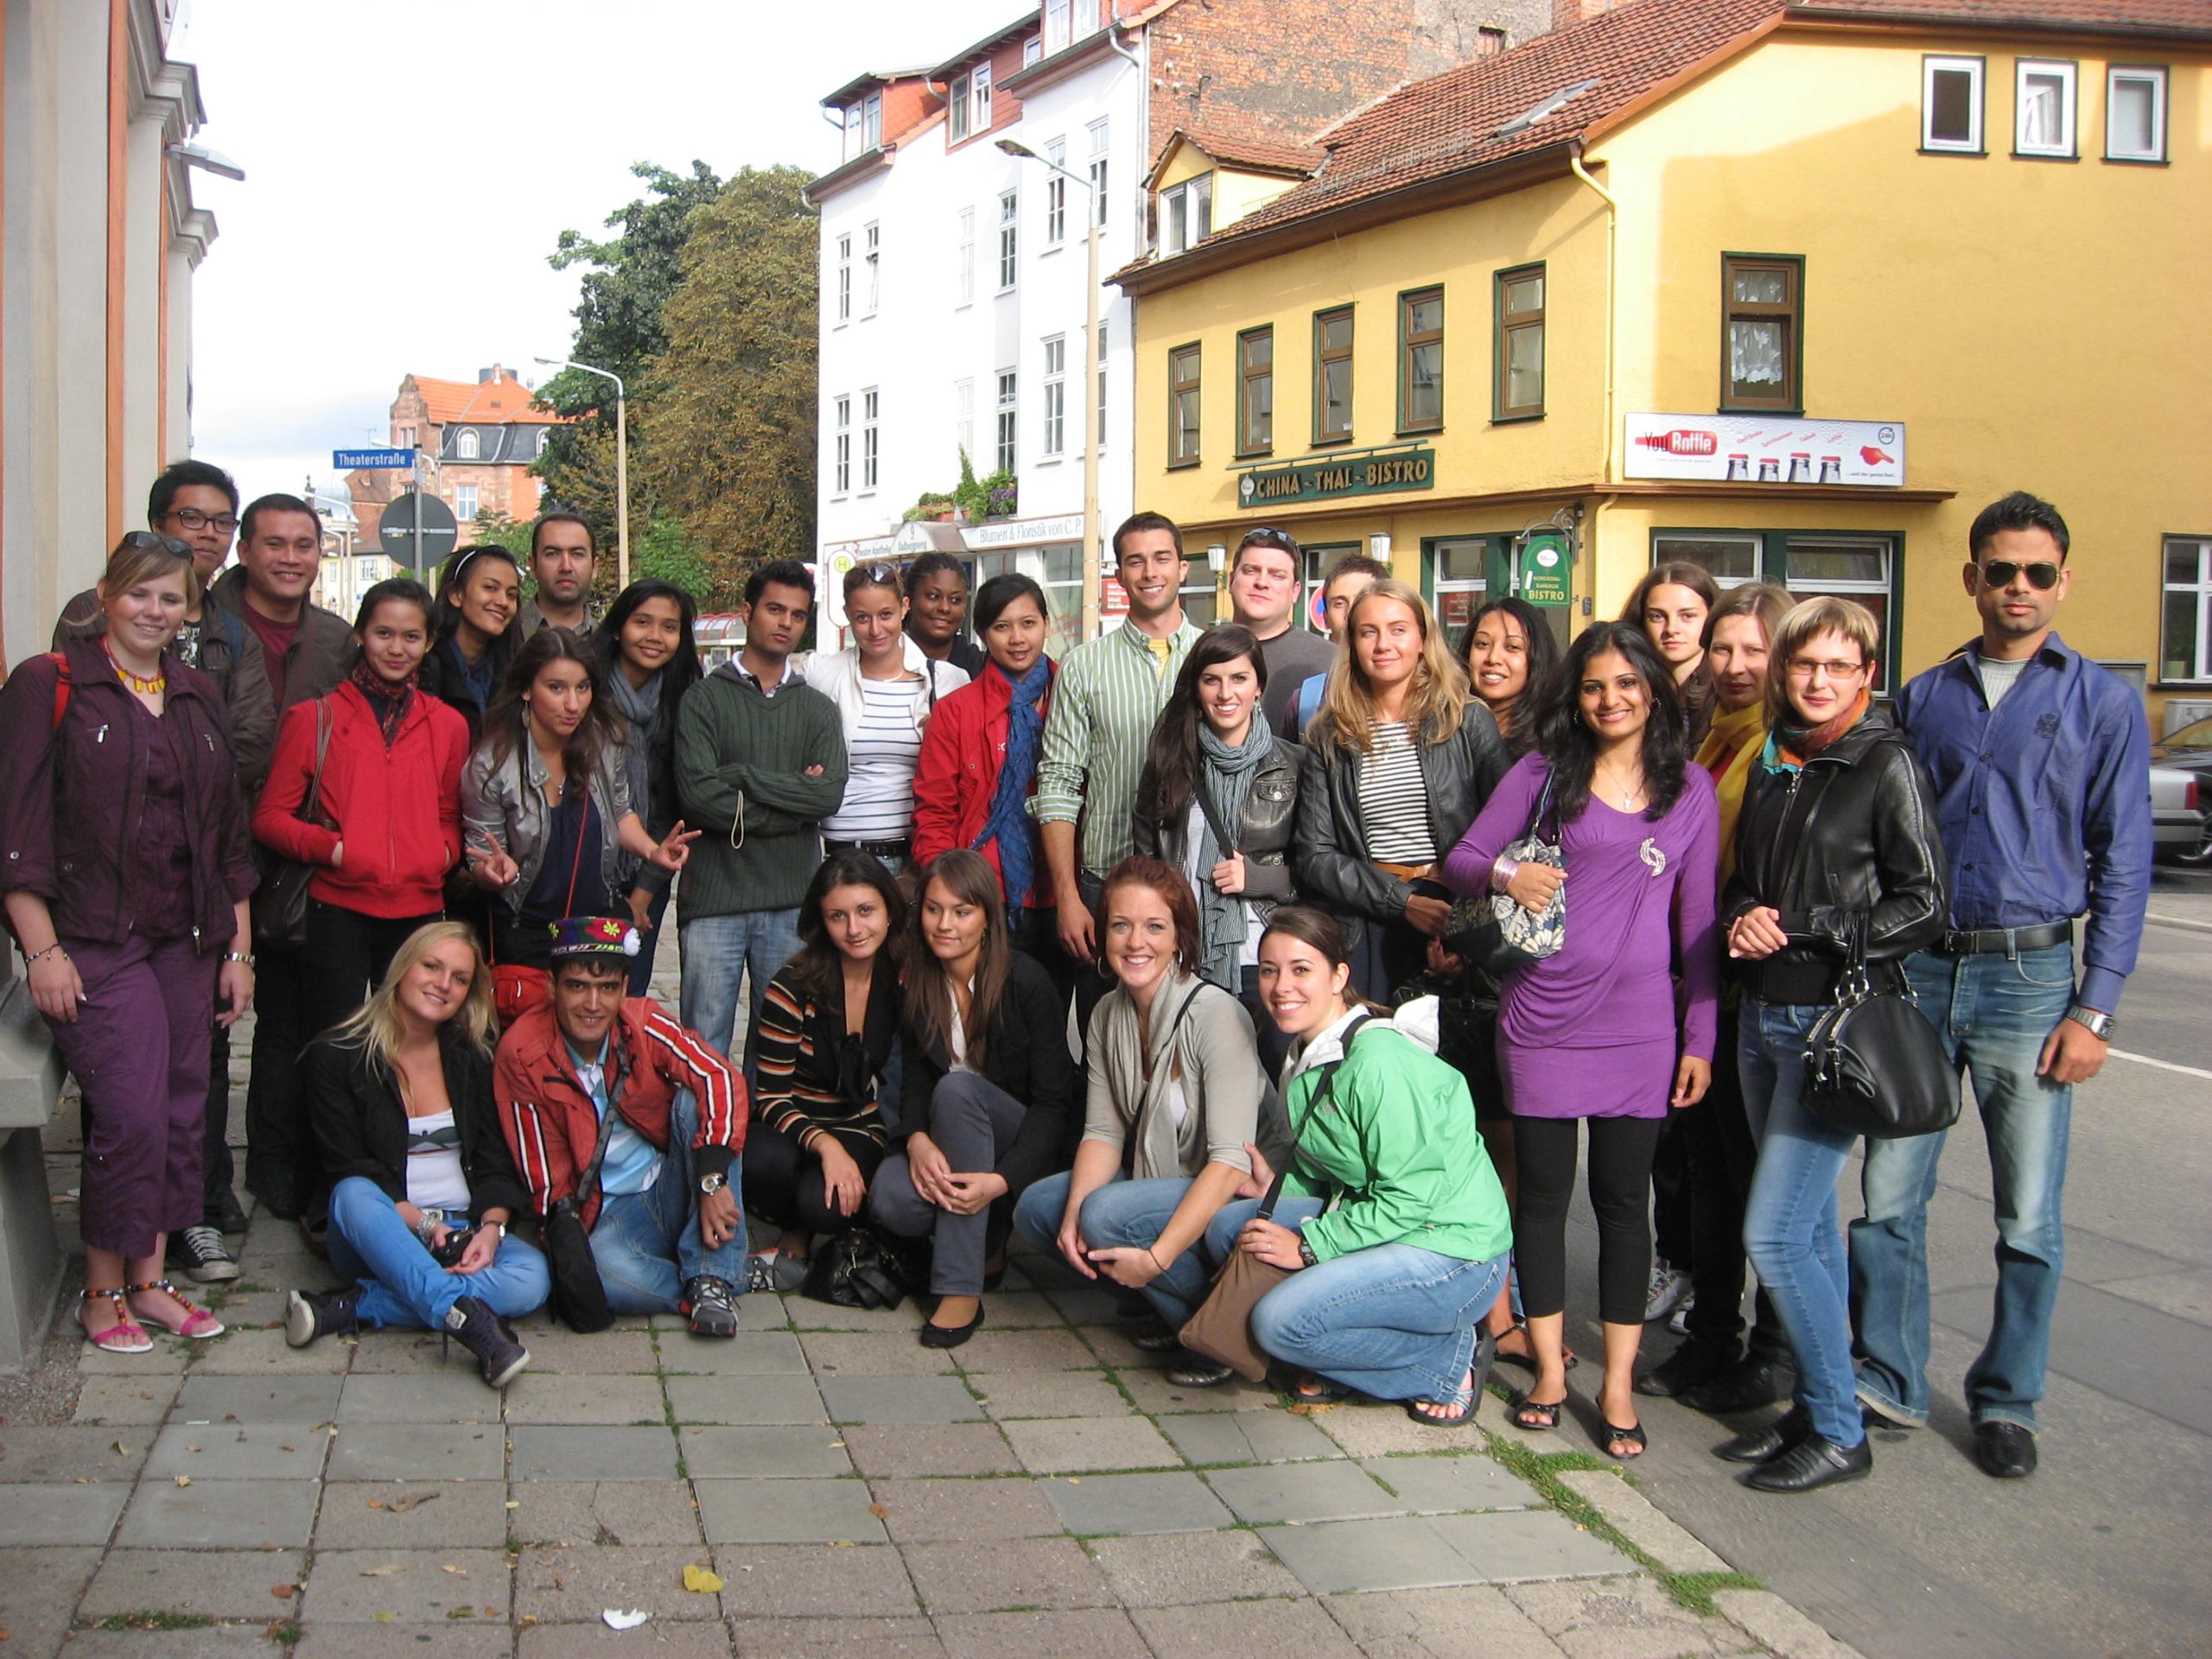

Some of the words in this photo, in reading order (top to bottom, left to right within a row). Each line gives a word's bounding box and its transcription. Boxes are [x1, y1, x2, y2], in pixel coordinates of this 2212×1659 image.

[1644, 431, 1668, 452] You
[1671, 431, 1712, 453] Bottle
[338, 452, 405, 466] Theaterstraße
[1256, 474, 1300, 499] CHINA
[1314, 466, 1352, 492] THAI
[1366, 458, 1428, 486] BISTRO
[980, 527, 1007, 543] Blumen
[1009, 525, 1015, 540] &
[1017, 521, 1046, 539] Floristik
[1048, 523, 1063, 536] von
[837, 560, 847, 570] H
[1528, 589, 1565, 601] BISTRO
